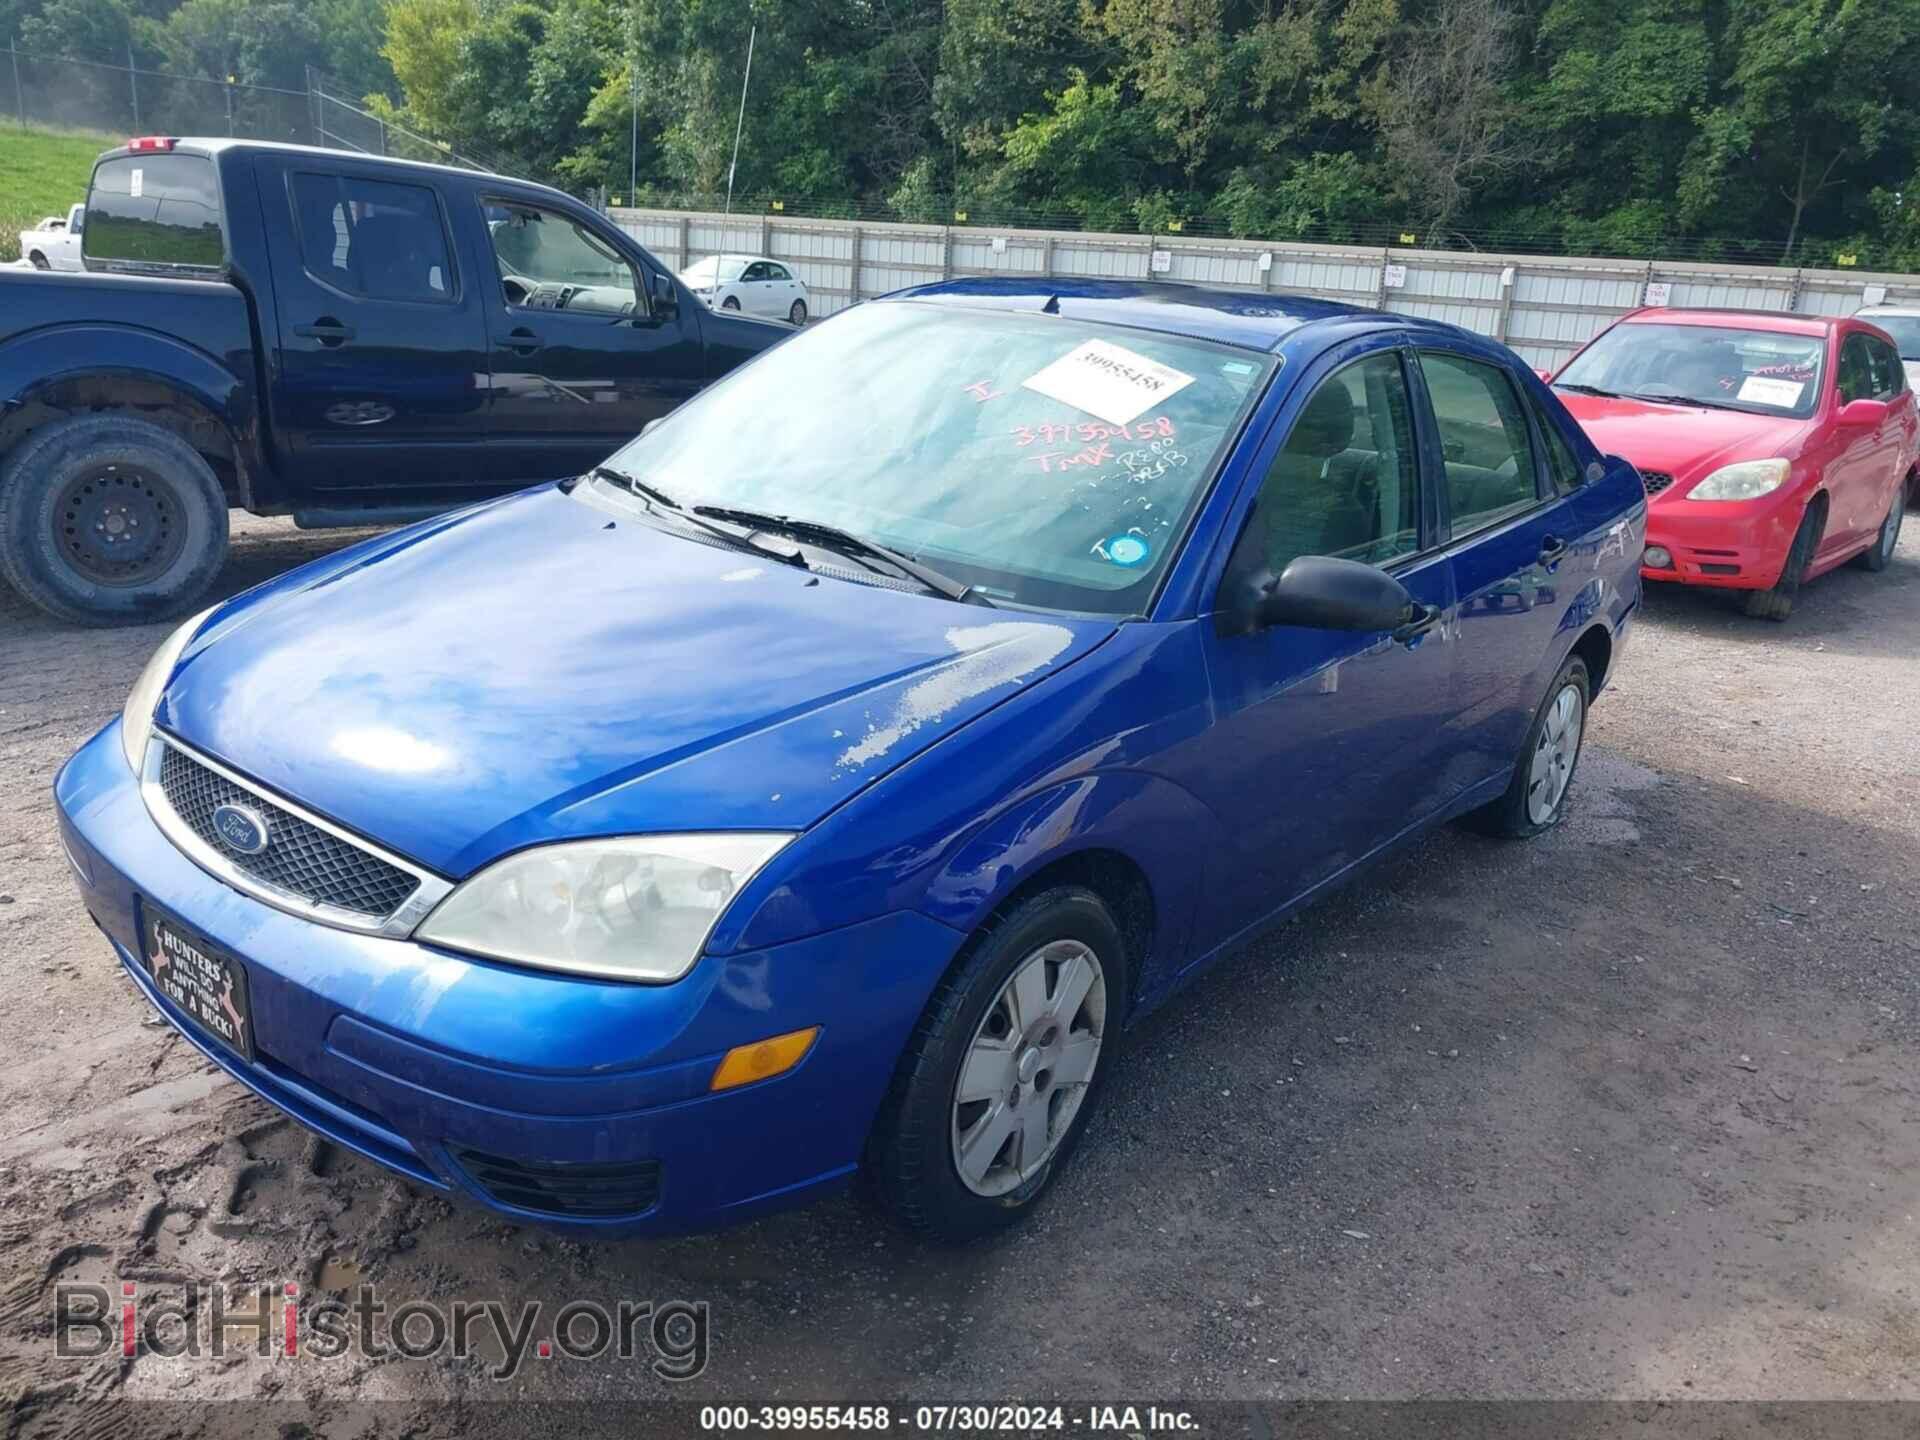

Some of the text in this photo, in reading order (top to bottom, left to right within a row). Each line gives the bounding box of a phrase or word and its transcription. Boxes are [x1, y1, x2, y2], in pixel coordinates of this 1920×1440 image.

[1077, 351, 1165, 392] 39955458
[223, 813, 253, 843] Ford
[164, 930, 220, 981] HUNTERS
[174, 955, 214, 992] WILL DO
[164, 978, 233, 1039] FOR A BUCK!
[172, 969, 220, 1012] ANYTHING
